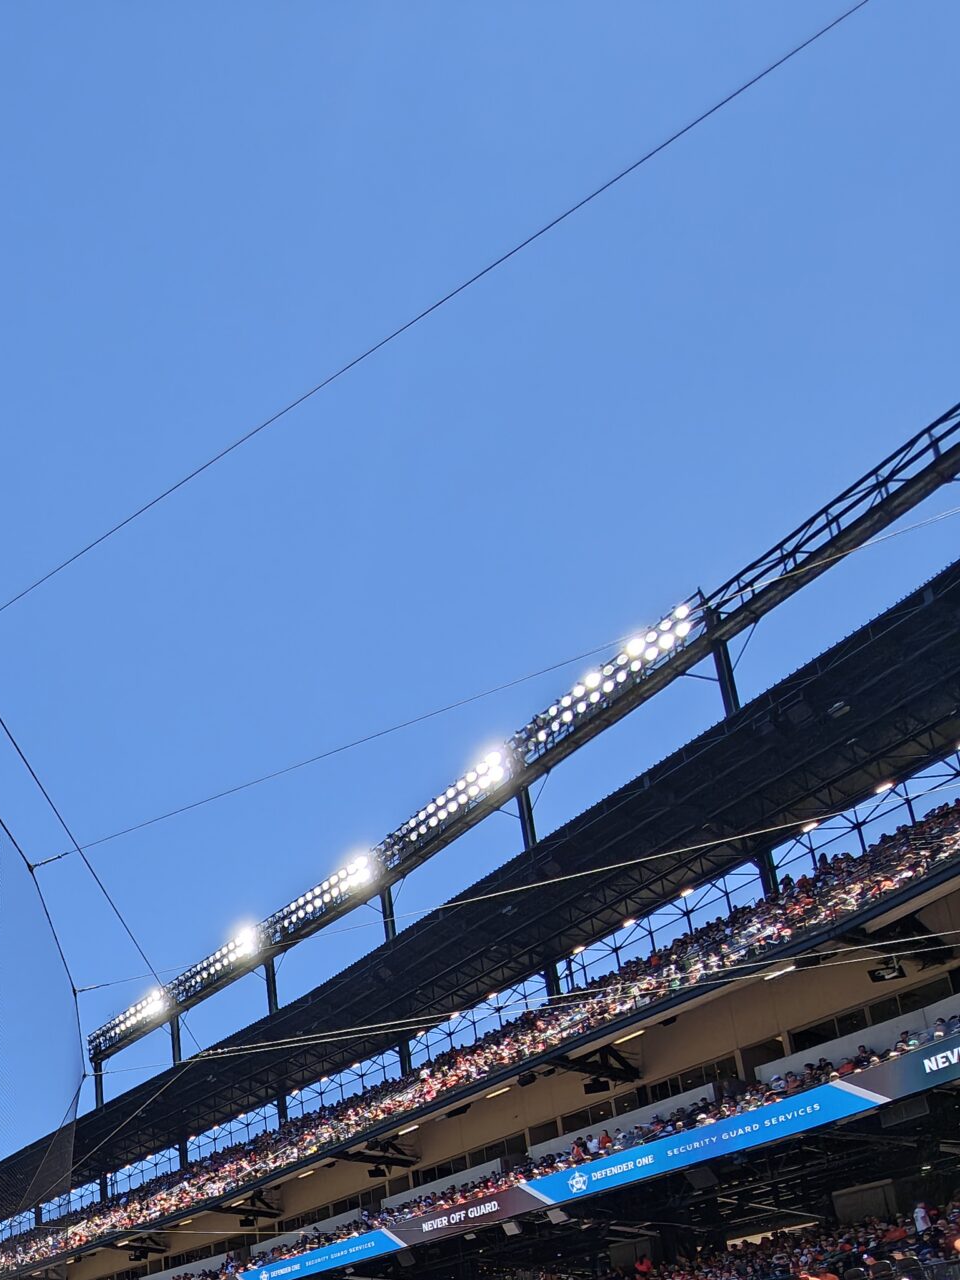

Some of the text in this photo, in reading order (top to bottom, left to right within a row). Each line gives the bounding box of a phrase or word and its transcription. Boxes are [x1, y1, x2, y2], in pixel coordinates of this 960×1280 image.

[923, 1047, 960, 1074] NEV
[666, 1103, 821, 1157] SECURITY GUARD SERVICES
[592, 1154, 655, 1181] DEFENDER ONE
[421, 1201, 500, 1233] NEVER OFF GUARD.
[305, 1241, 375, 1267] SECURITY GUARD SERVICES
[270, 1263, 301, 1278] DEFENDER ONE
